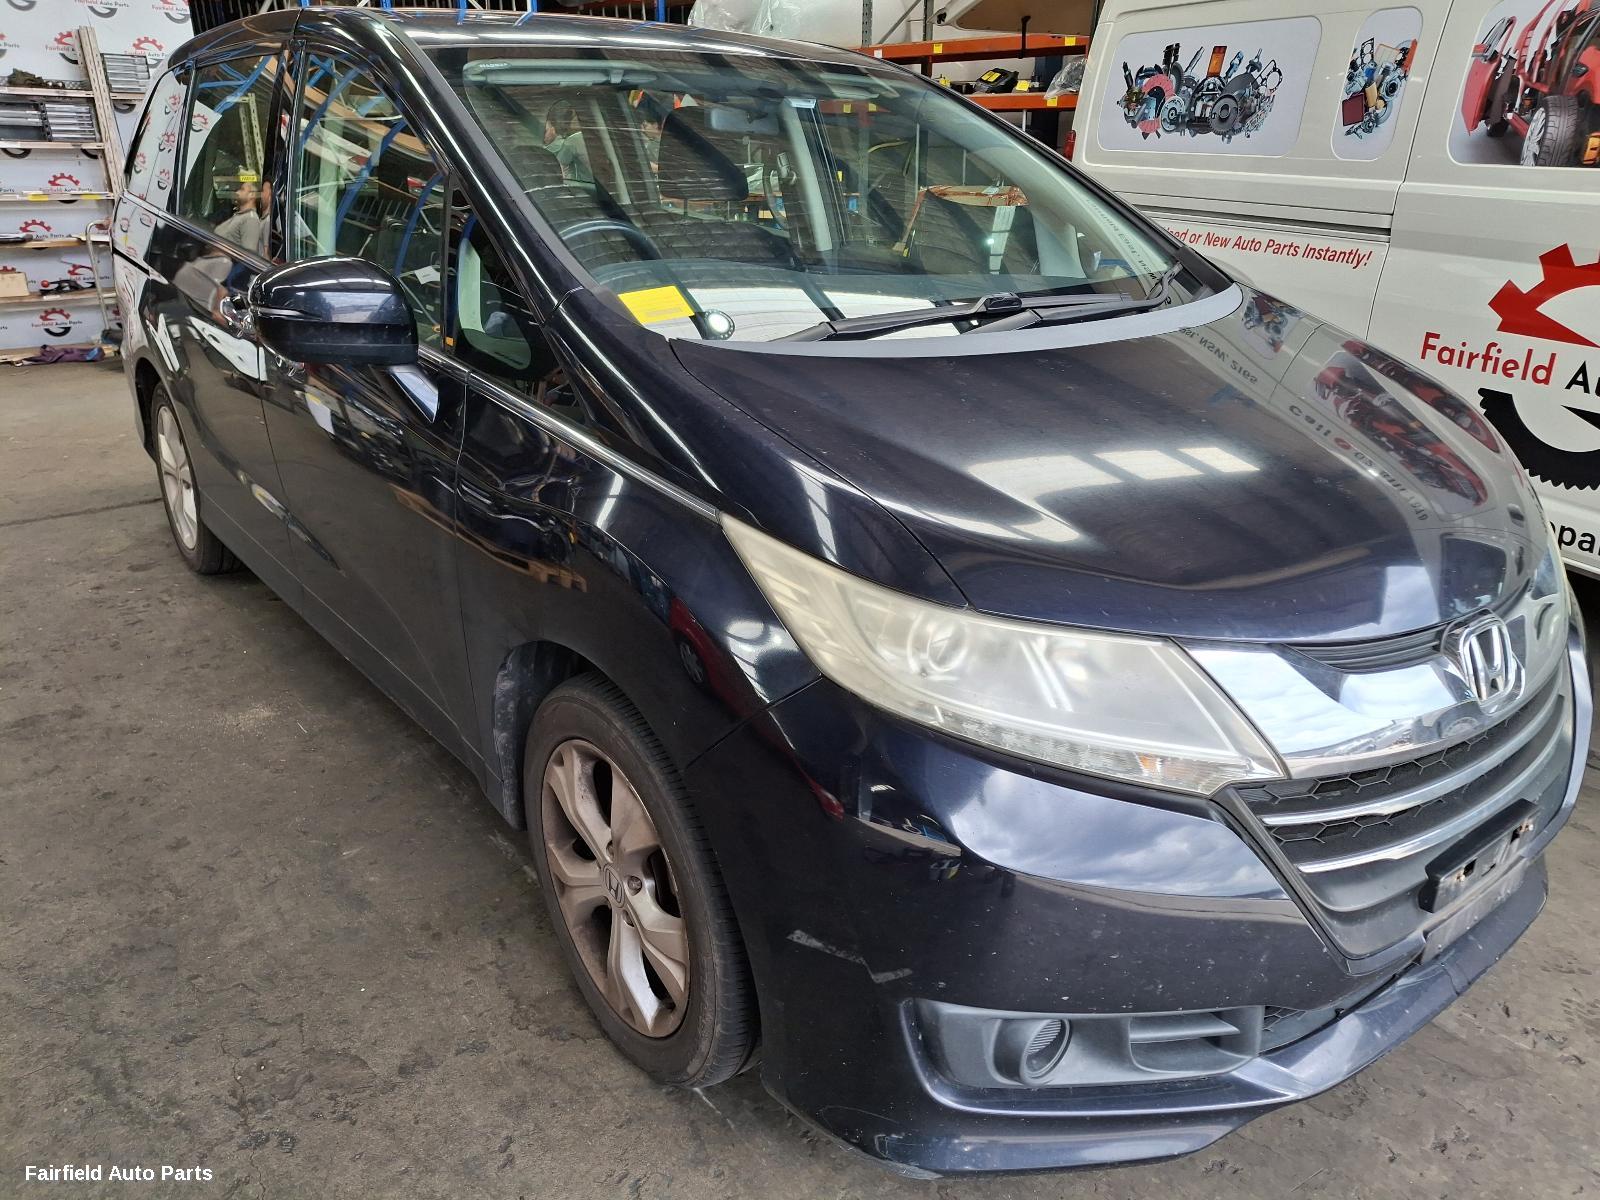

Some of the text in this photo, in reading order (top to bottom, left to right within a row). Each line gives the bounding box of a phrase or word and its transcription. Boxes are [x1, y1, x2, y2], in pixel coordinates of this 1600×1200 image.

[1189, 232, 1203, 244] or
[1203, 231, 1232, 249] New
[1232, 235, 1262, 252] Auto
[1264, 239, 1300, 257] Parts
[1302, 243, 1373, 269] Instantly!
[1421, 332, 1557, 386] Fairfield
